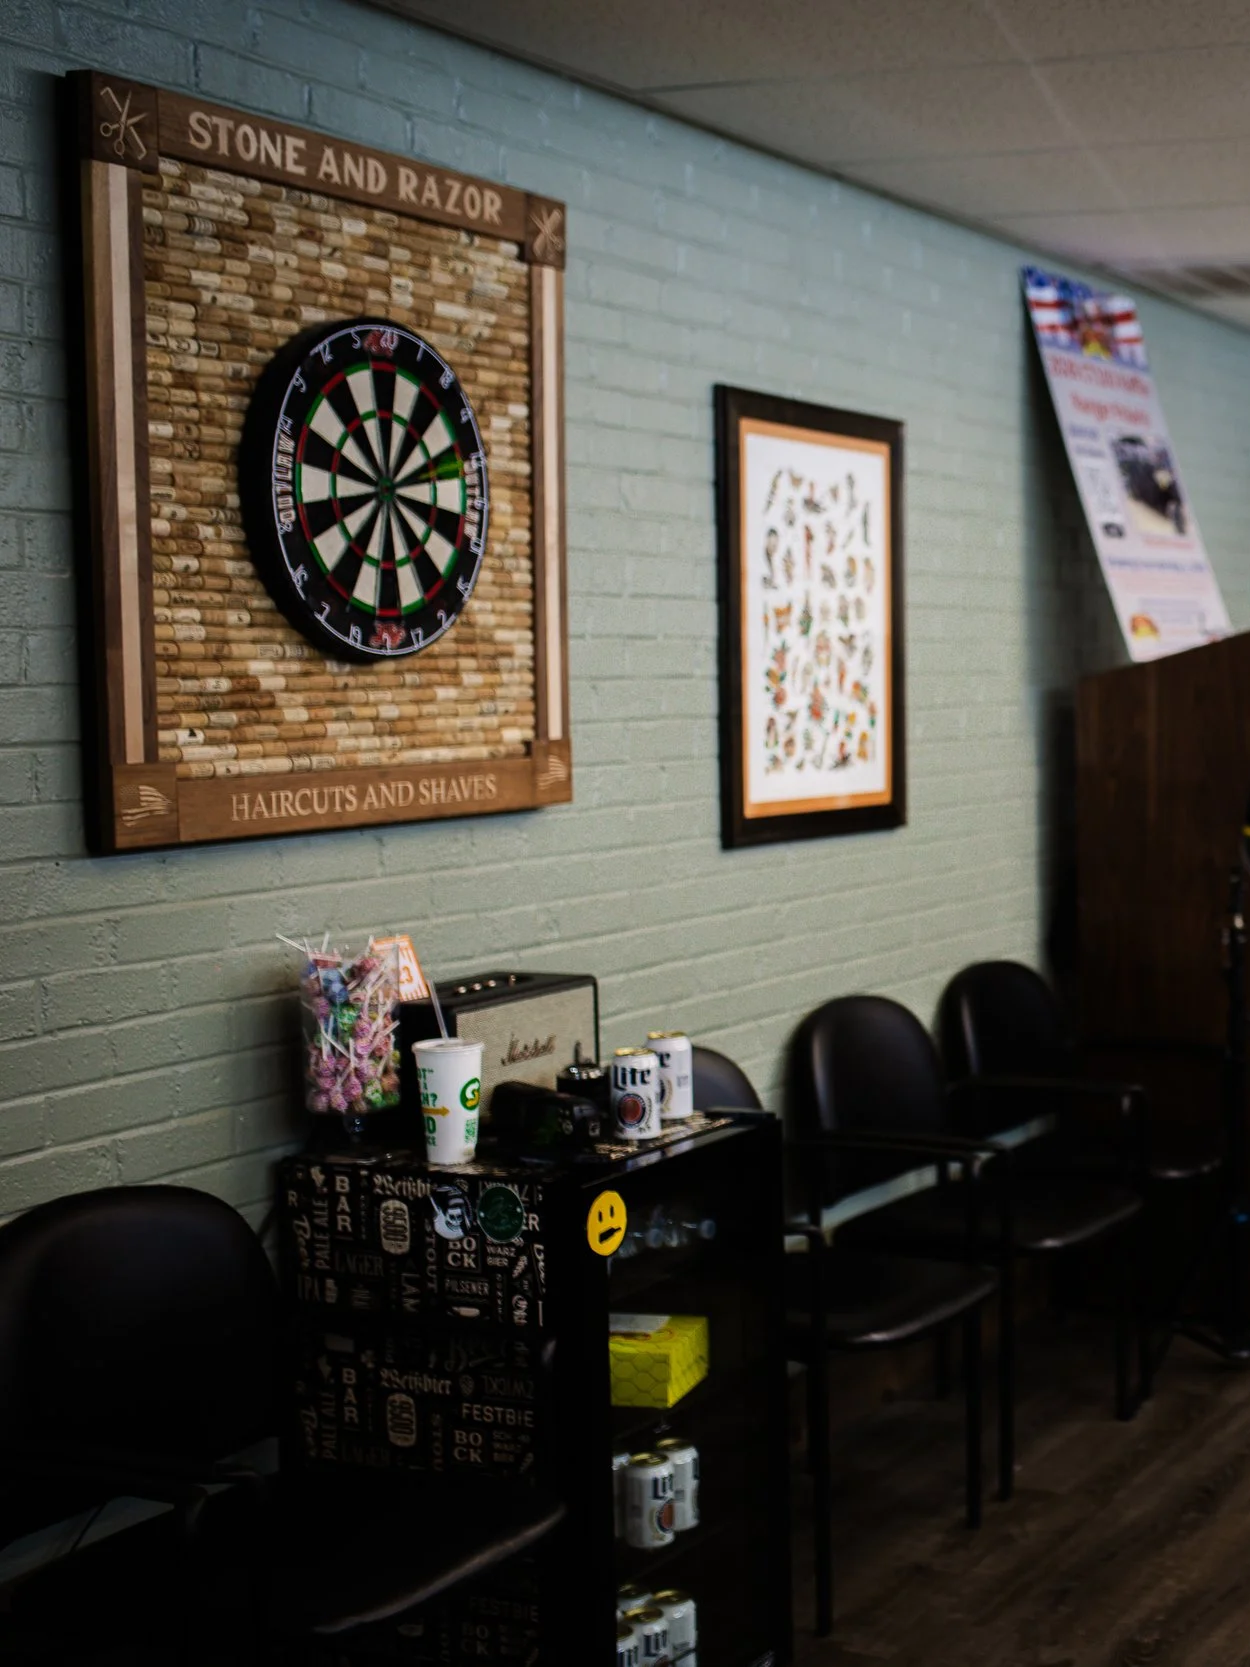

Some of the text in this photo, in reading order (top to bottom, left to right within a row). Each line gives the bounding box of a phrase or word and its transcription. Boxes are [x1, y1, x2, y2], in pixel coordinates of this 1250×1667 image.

[187, 110, 503, 226] STONE AND RAZOR
[230, 774, 498, 822] HAIRCUTS AND SHAVES
[613, 1065, 651, 1091] Lite
[334, 1174, 354, 1234] BAR
[340, 1366, 360, 1426] BAR
[452, 1446, 484, 1465] CK
[453, 1429, 483, 1447] BO
